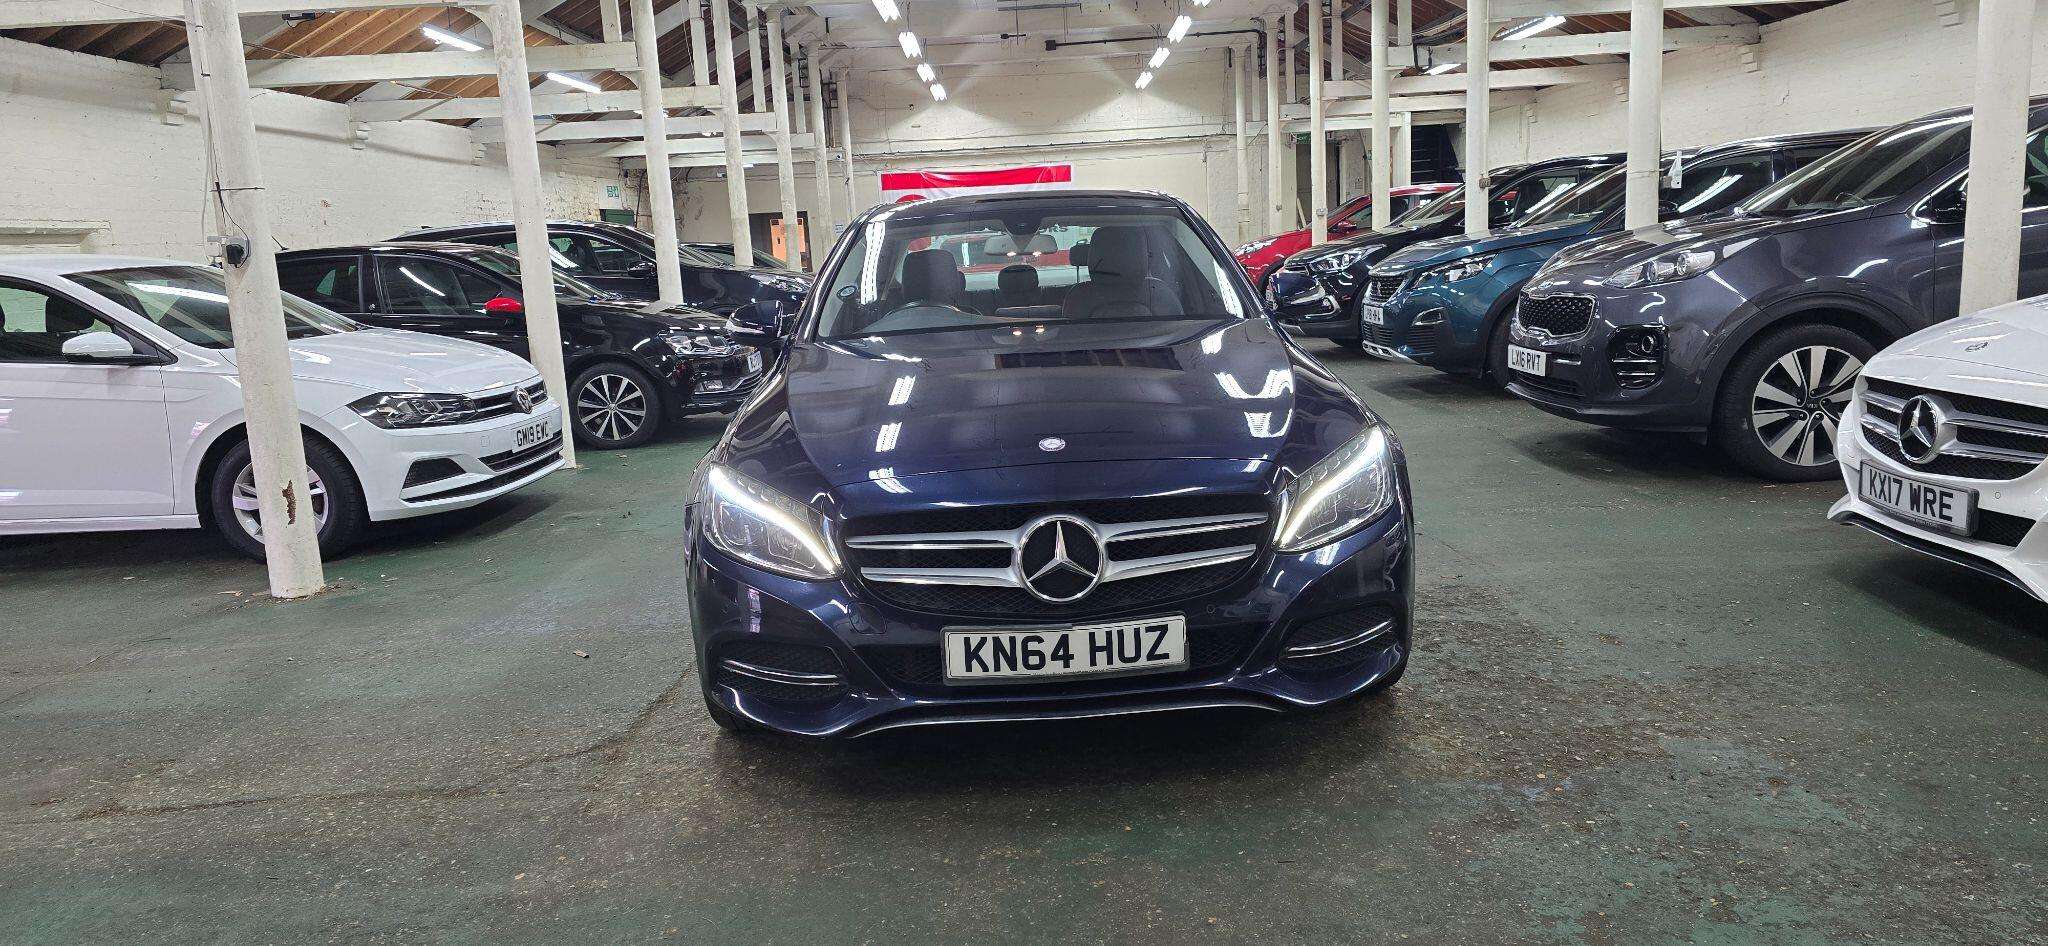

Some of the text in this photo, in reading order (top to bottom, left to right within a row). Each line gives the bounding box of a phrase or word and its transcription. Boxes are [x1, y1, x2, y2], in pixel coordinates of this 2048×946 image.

[1511, 349, 1540, 371] LX16 RVT
[517, 425, 534, 446] GM19
[1869, 468, 1903, 506] KX17
[1909, 483, 1954, 523] WRE
[963, 623, 1170, 673] KN64 HUZ
